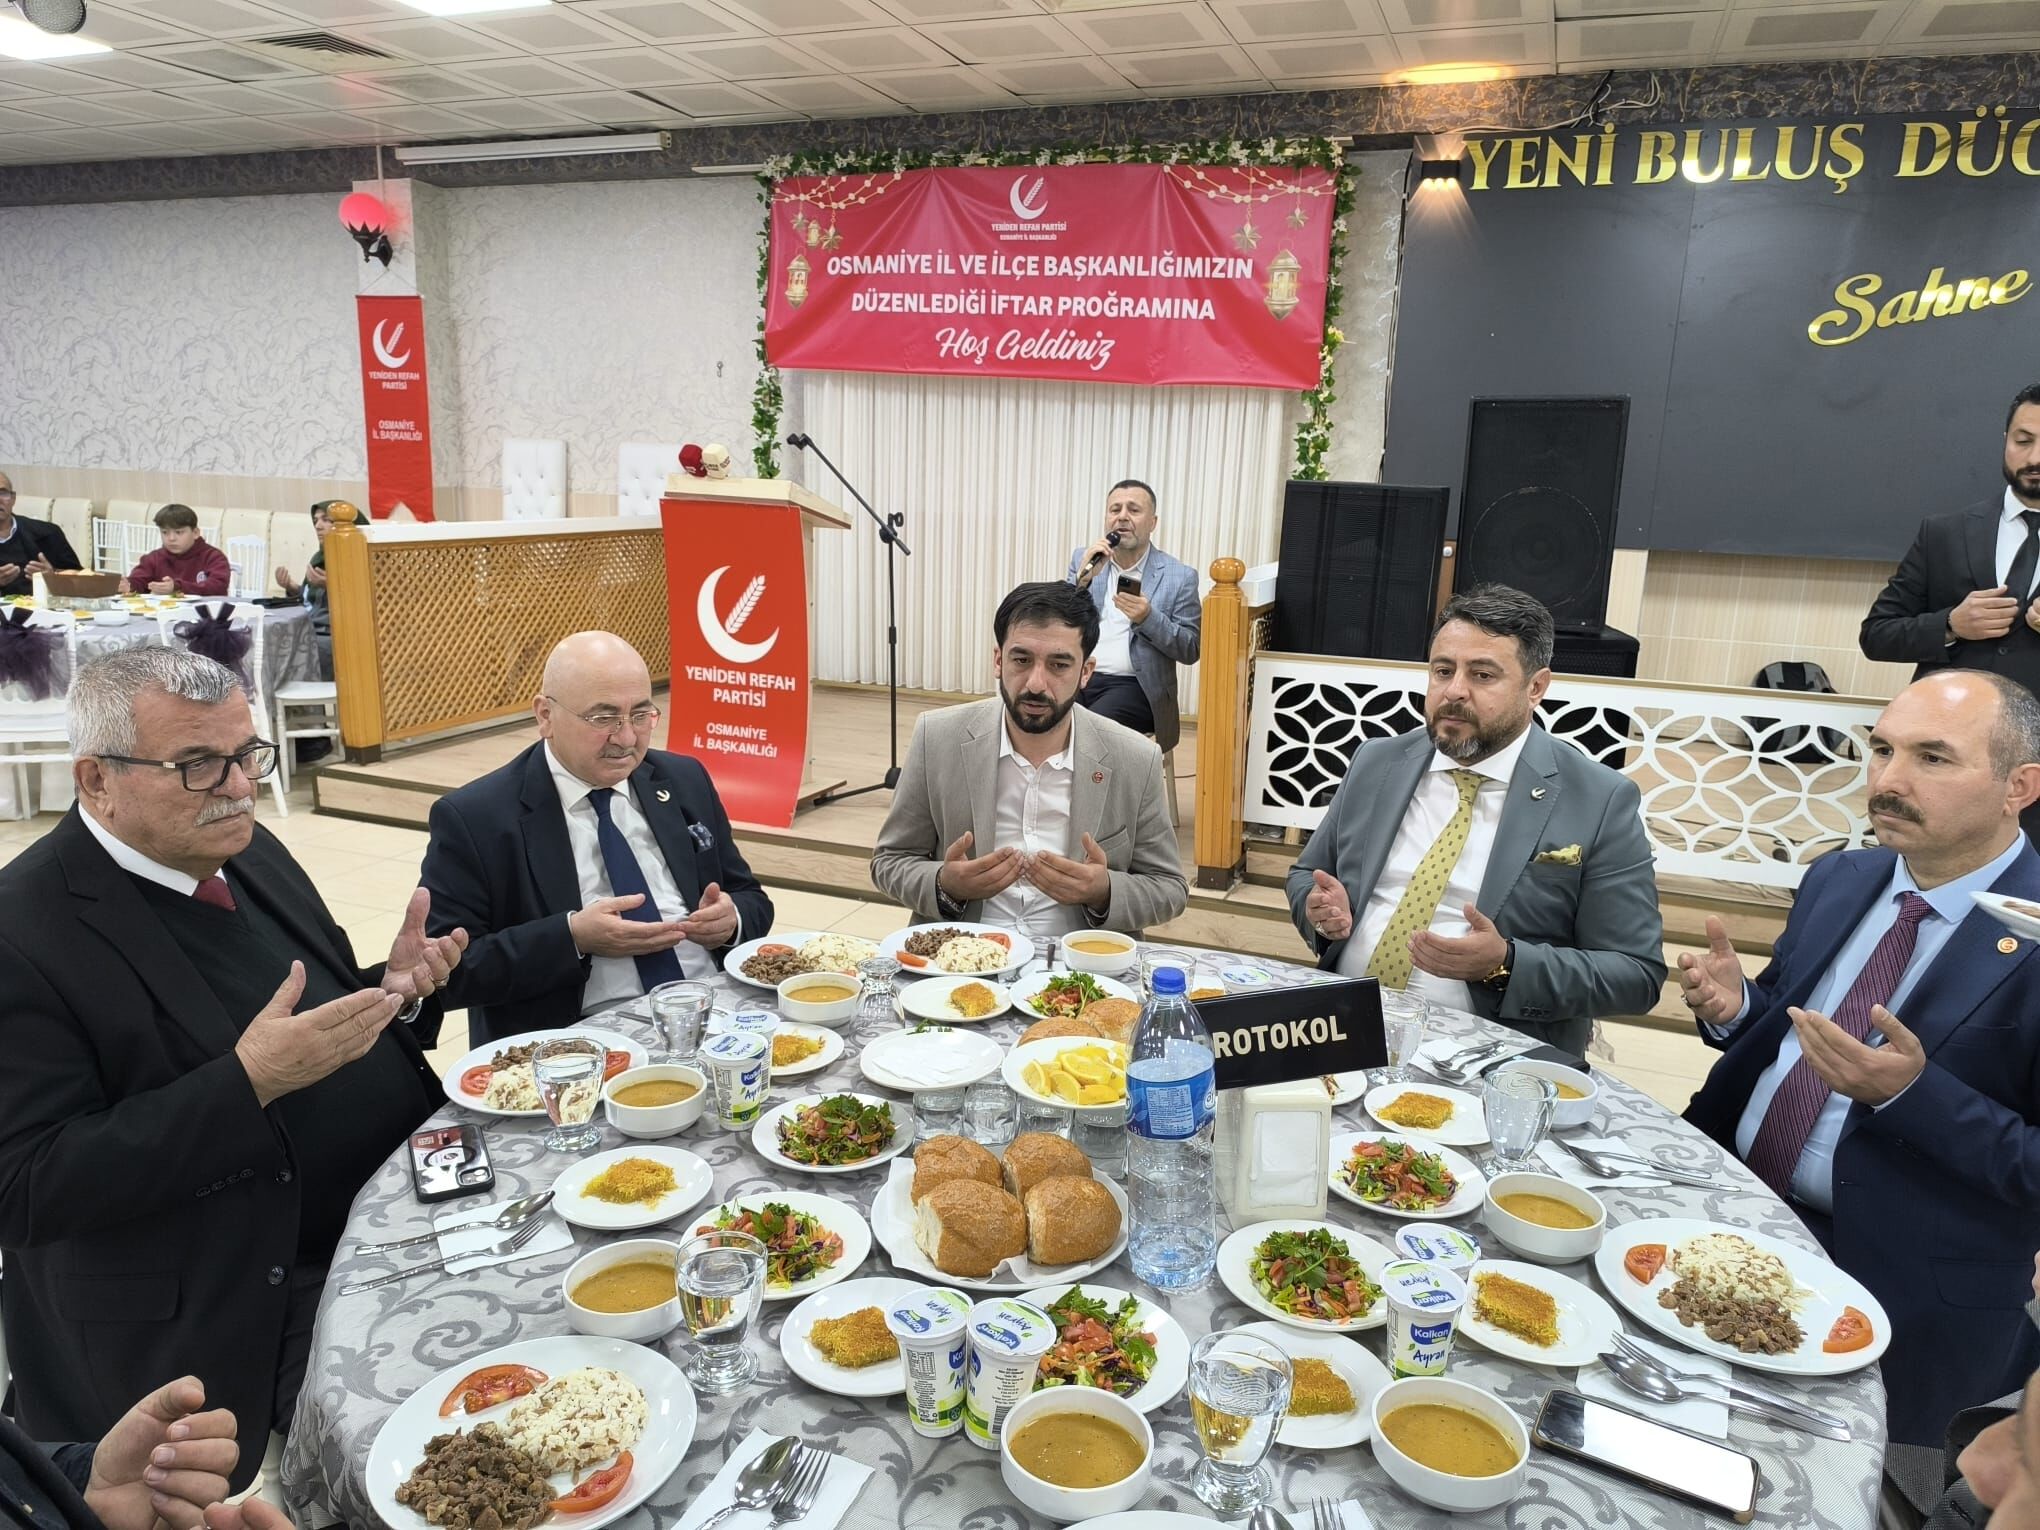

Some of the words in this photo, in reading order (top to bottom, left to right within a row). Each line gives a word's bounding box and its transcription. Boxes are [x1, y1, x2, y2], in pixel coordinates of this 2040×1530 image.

[1464, 123, 1618, 190] YENİ
[1632, 123, 1865, 193] BULUŞ
[827, 249, 932, 276] OSMANİYE
[937, 249, 956, 275] İL
[959, 255, 987, 276] VE
[991, 250, 1039, 281] İLÇE
[1044, 250, 1253, 282] BAŞKANLIĞIMIZIN
[851, 288, 986, 313] DÜZENLEDİĞİ
[991, 289, 1053, 316] İFTAR
[1057, 290, 1215, 320] PROĞRAMINA
[1807, 266, 2034, 347] Sahne
[935, 327, 989, 365] Hoş
[995, 328, 1116, 371] Geldiniz
[685, 665, 746, 686] YENİDEN
[749, 672, 796, 691] REFAH
[713, 688, 766, 707] PARTİSİ
[706, 722, 768, 741] OSMANİYE
[693, 733, 704, 748] İL
[706, 738, 777, 758] BAŞKANLIĞI
[1414, 1327, 1449, 1339] Kalkan
[1413, 1350, 1445, 1368] Ayran
